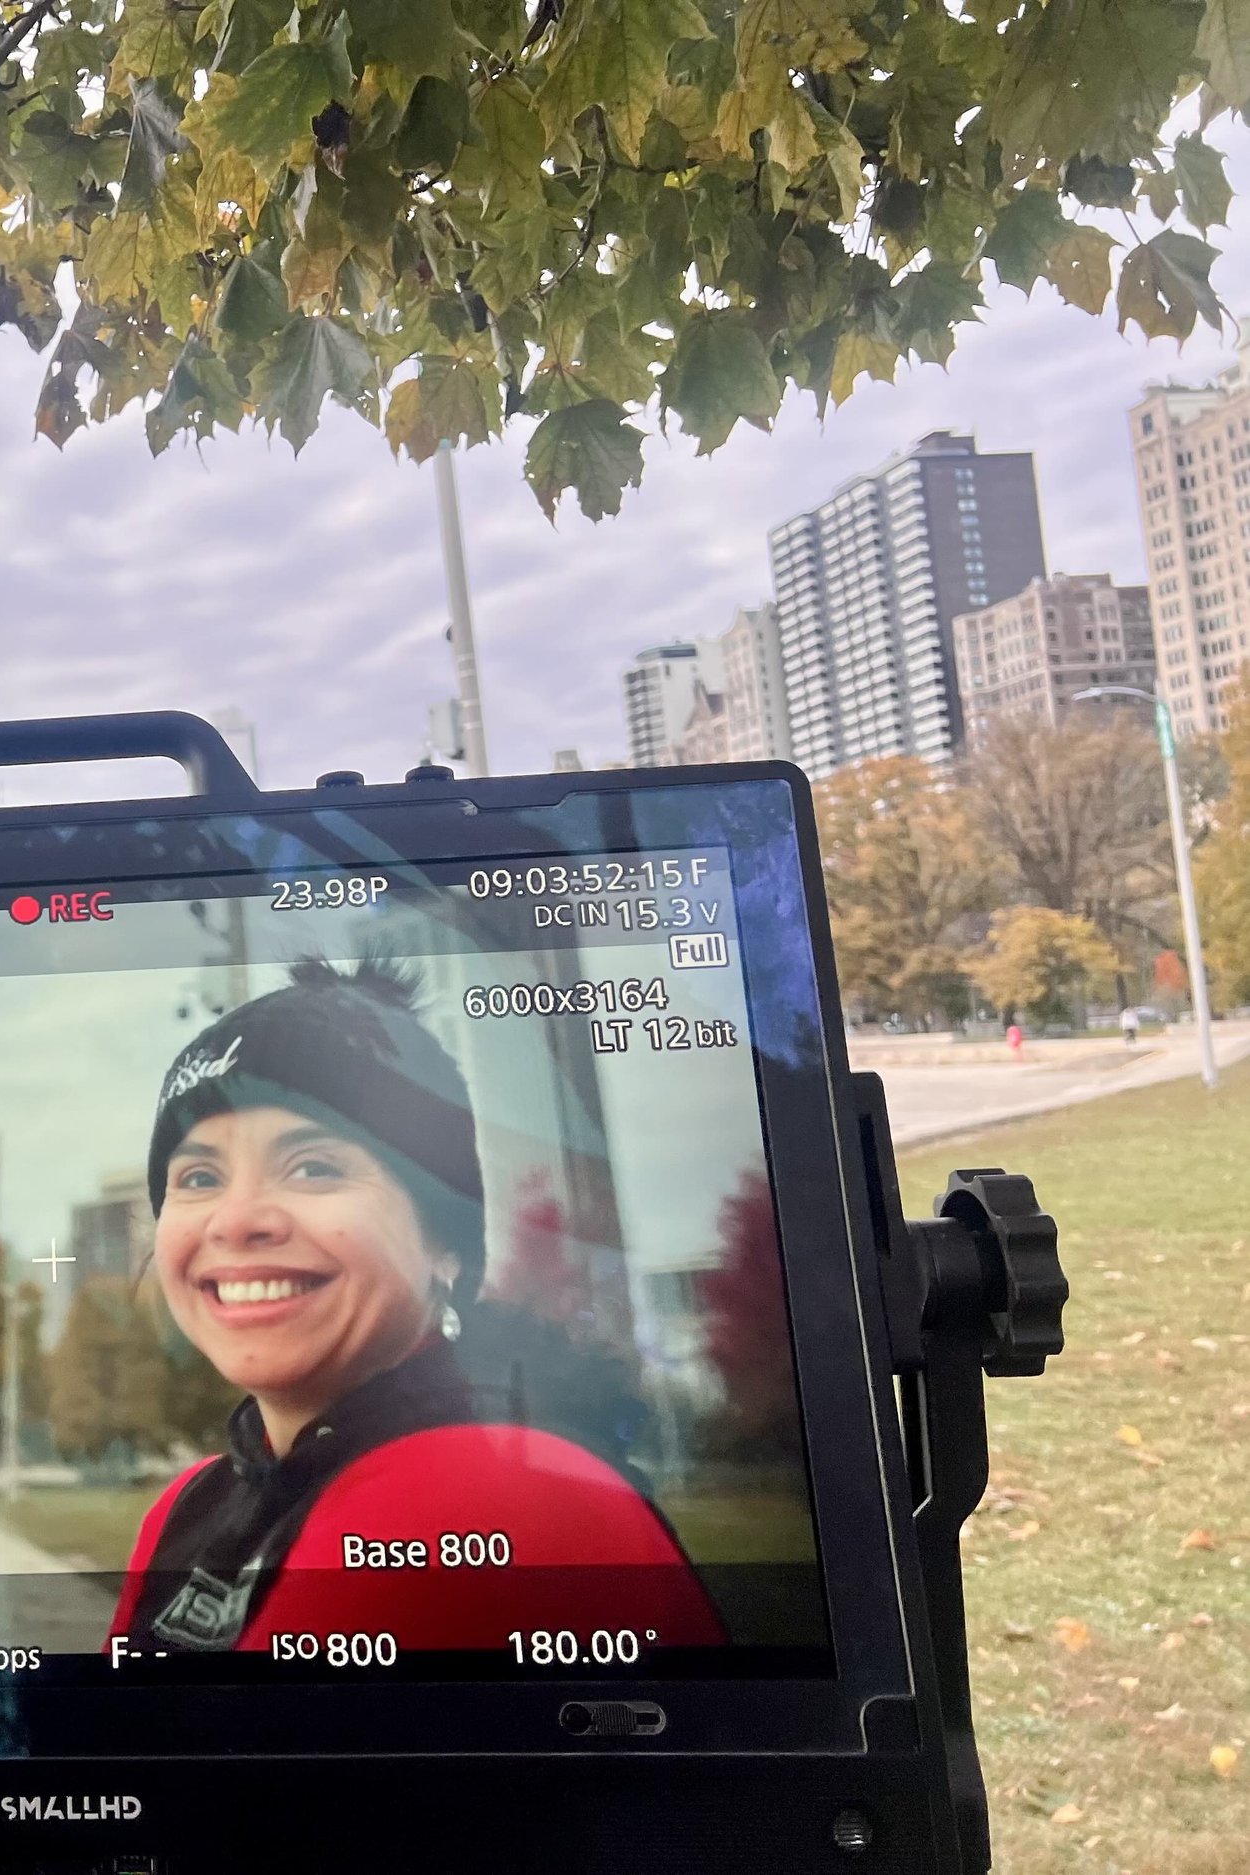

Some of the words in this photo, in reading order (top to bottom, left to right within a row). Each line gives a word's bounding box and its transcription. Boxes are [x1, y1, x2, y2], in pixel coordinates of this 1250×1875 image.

[50, 891, 114, 922] REC
[272, 876, 390, 911] 23.98P
[534, 903, 572, 928] DC
[580, 902, 607, 926] IN
[615, 898, 692, 929] 15.3
[699, 902, 718, 925] V
[674, 936, 723, 963] Full
[465, 978, 668, 1018] 6000x3164
[592, 1020, 632, 1053] LT
[644, 1018, 690, 1050] 12
[696, 1021, 737, 1047] bit
[342, 1535, 427, 1568] Base
[439, 1533, 510, 1567] 800
[271, 1633, 319, 1661] ISO
[326, 1632, 397, 1667] 800
[0, 1795, 142, 1820] SMALLHD
